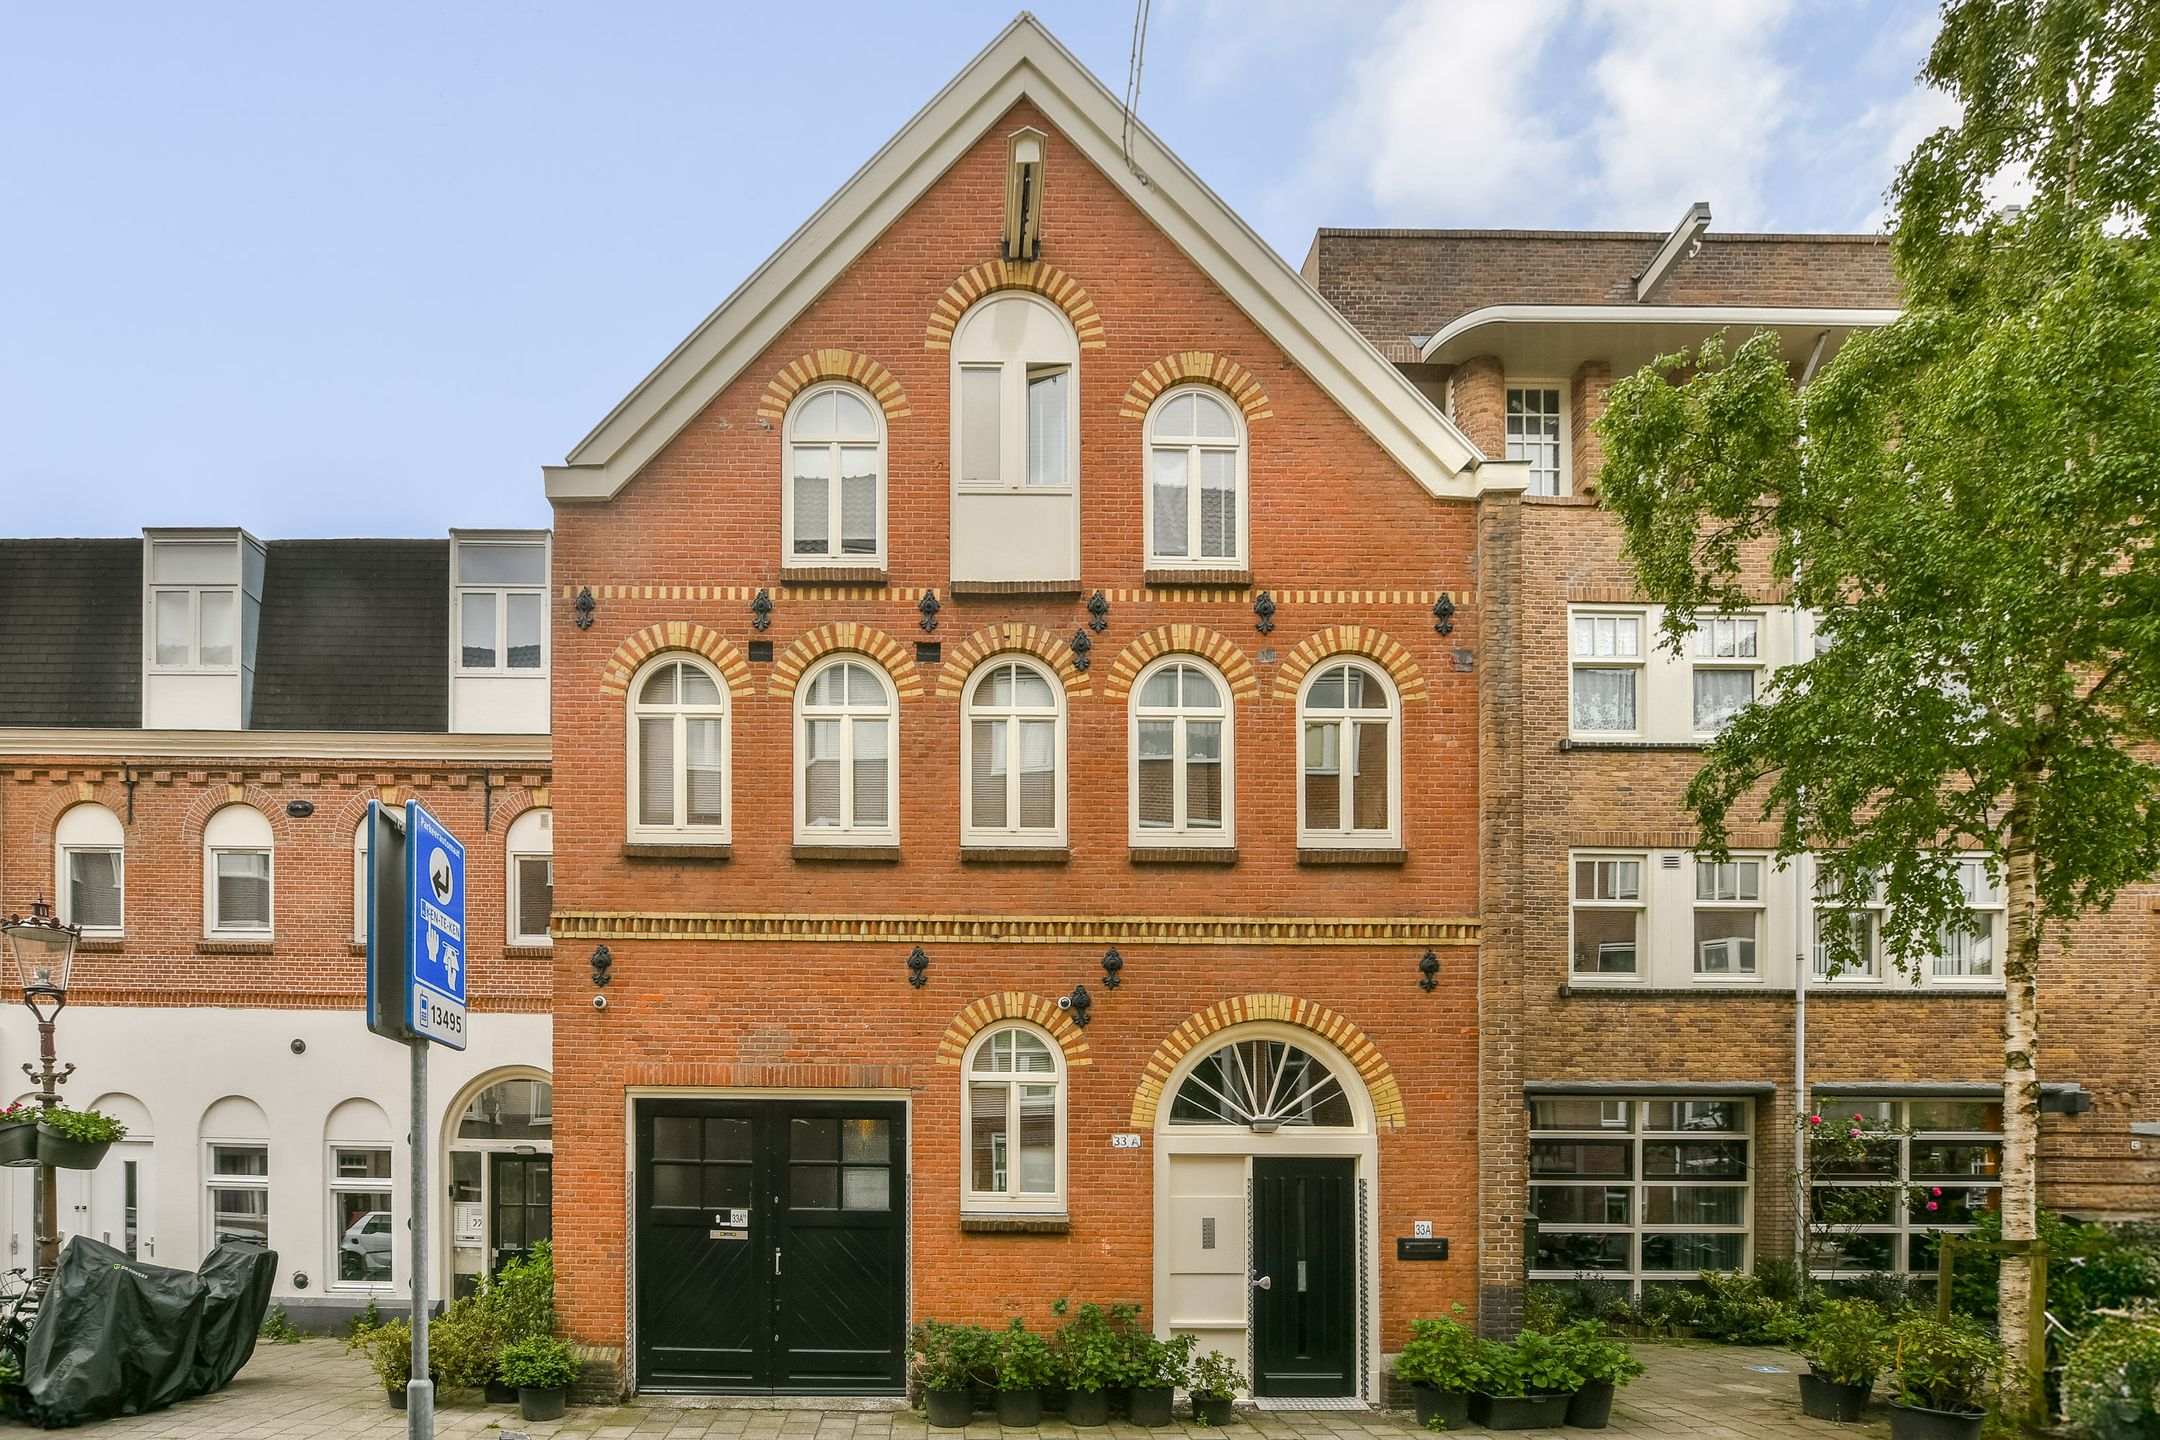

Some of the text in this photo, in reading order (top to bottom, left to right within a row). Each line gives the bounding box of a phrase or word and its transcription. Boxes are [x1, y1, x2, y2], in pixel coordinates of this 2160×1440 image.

[420, 815, 461, 859] Parkeerautomaat
[426, 905, 460, 938] KEN-TE-KEN
[431, 1004, 462, 1034] 13495
[1114, 1136, 1139, 1147] 33 A
[1415, 1224, 1431, 1236] 33A
